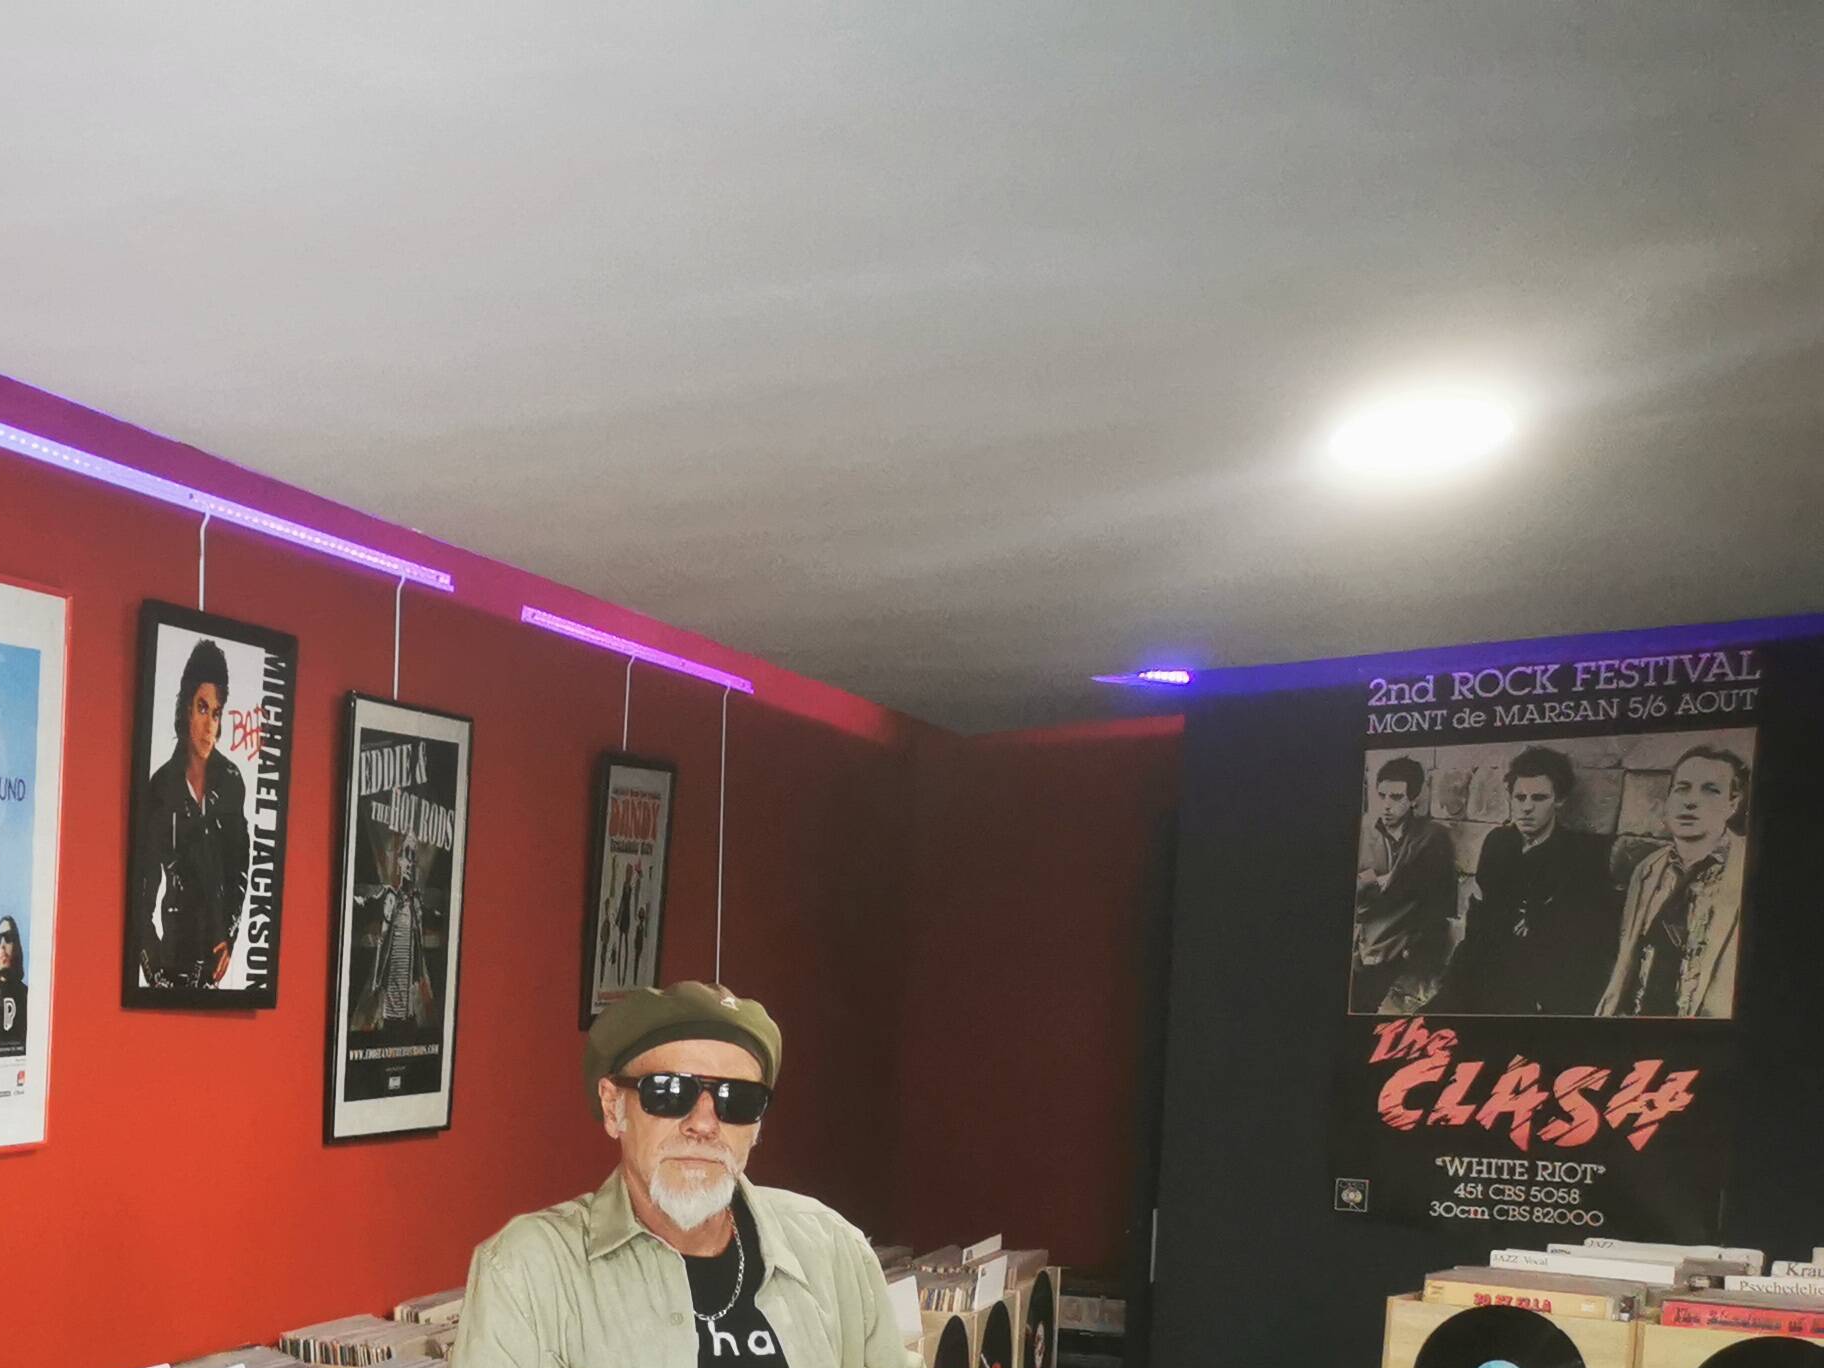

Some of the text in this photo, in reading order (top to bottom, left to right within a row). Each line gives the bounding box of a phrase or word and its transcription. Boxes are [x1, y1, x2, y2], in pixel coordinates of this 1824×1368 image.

[1367, 650, 1761, 707] 2nd ROCK FESTIVAL
[228, 704, 269, 762] BAD
[255, 649, 287, 815] MICHAEL
[1367, 688, 1760, 735] MONT de MARSAN 5/6 AOUT
[360, 741, 428, 796] EDDIE &
[370, 787, 455, 852] THE HOT RODS
[246, 824, 276, 990] JACKSON
[1368, 1016, 1459, 1064] The
[1377, 1054, 1701, 1152] CLASH
[1429, 1201, 1604, 1227] 30cm CBS 82000
[1454, 1182, 1580, 1205] 45t CBS 5058
